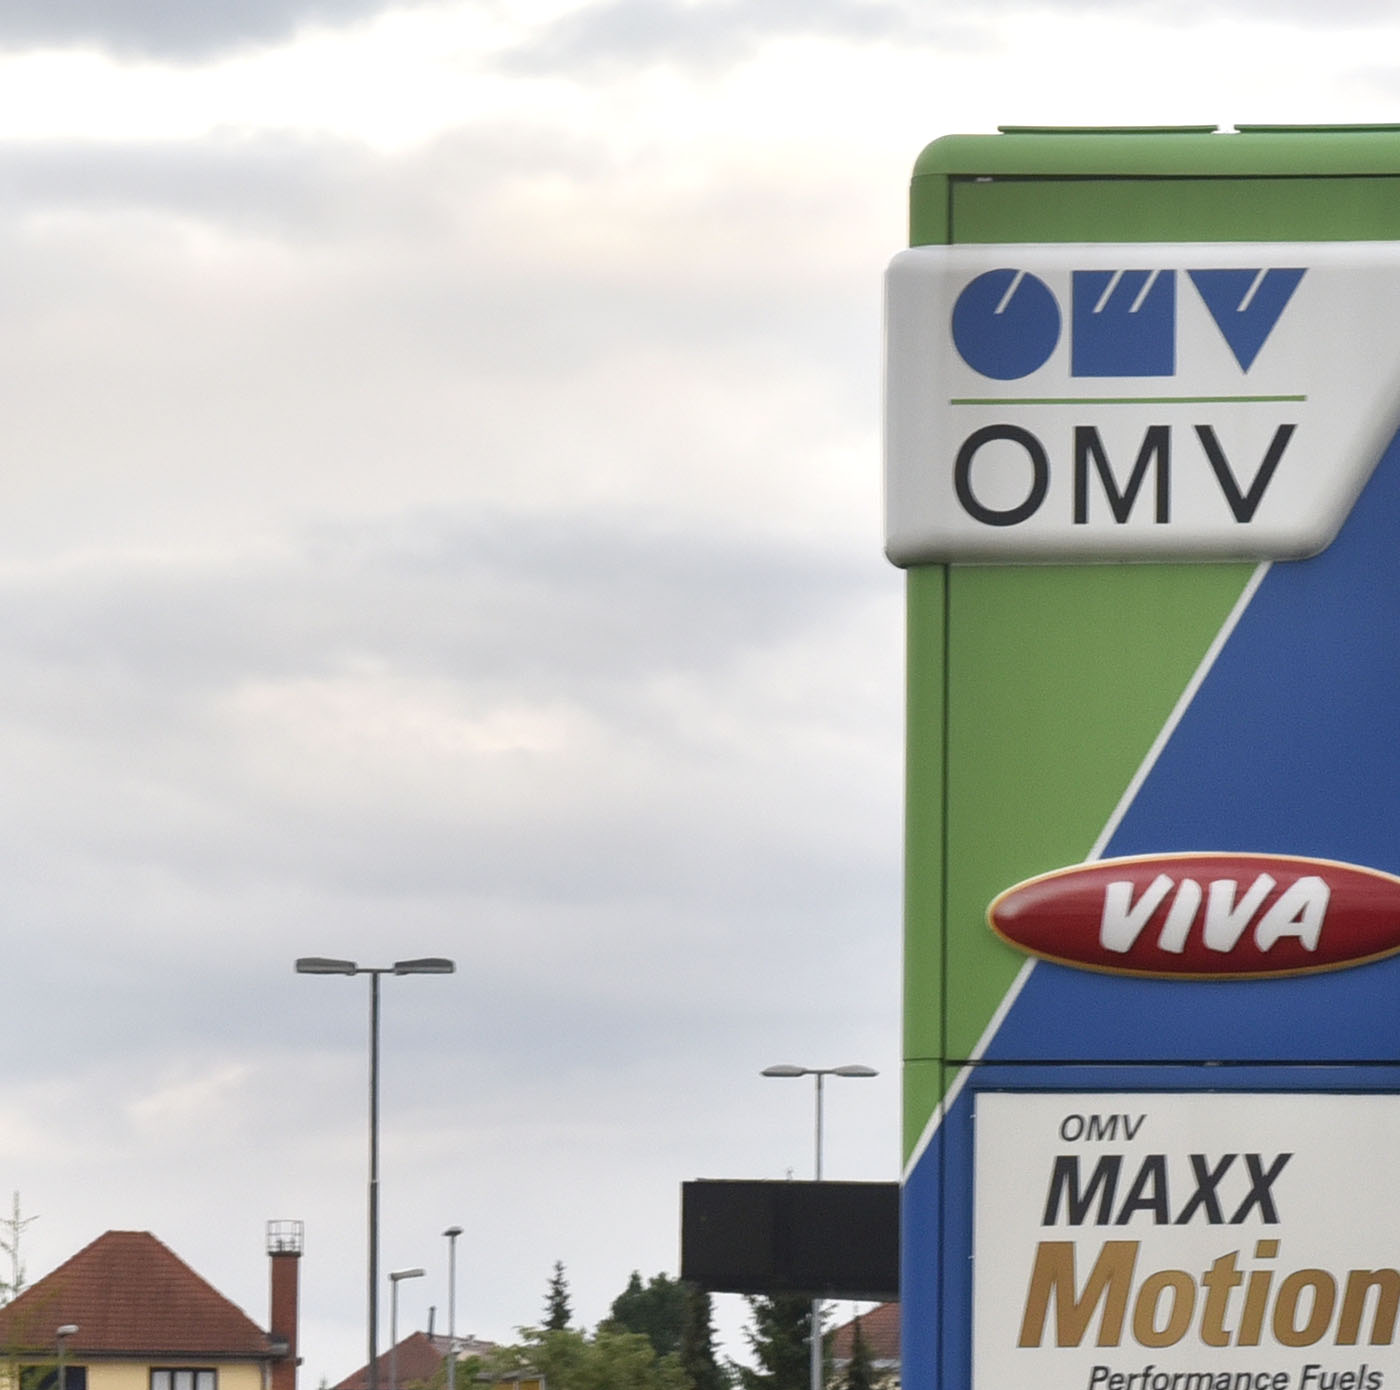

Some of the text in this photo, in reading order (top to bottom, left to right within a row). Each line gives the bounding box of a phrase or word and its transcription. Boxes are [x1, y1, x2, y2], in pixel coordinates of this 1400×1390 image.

[953, 422, 1299, 527] OMV
[1100, 872, 1332, 953] VIVA
[1058, 1113, 1147, 1142] OMV
[1040, 1152, 1295, 1226] MAXX
[1298, 1364, 1384, 1390] Fuels
